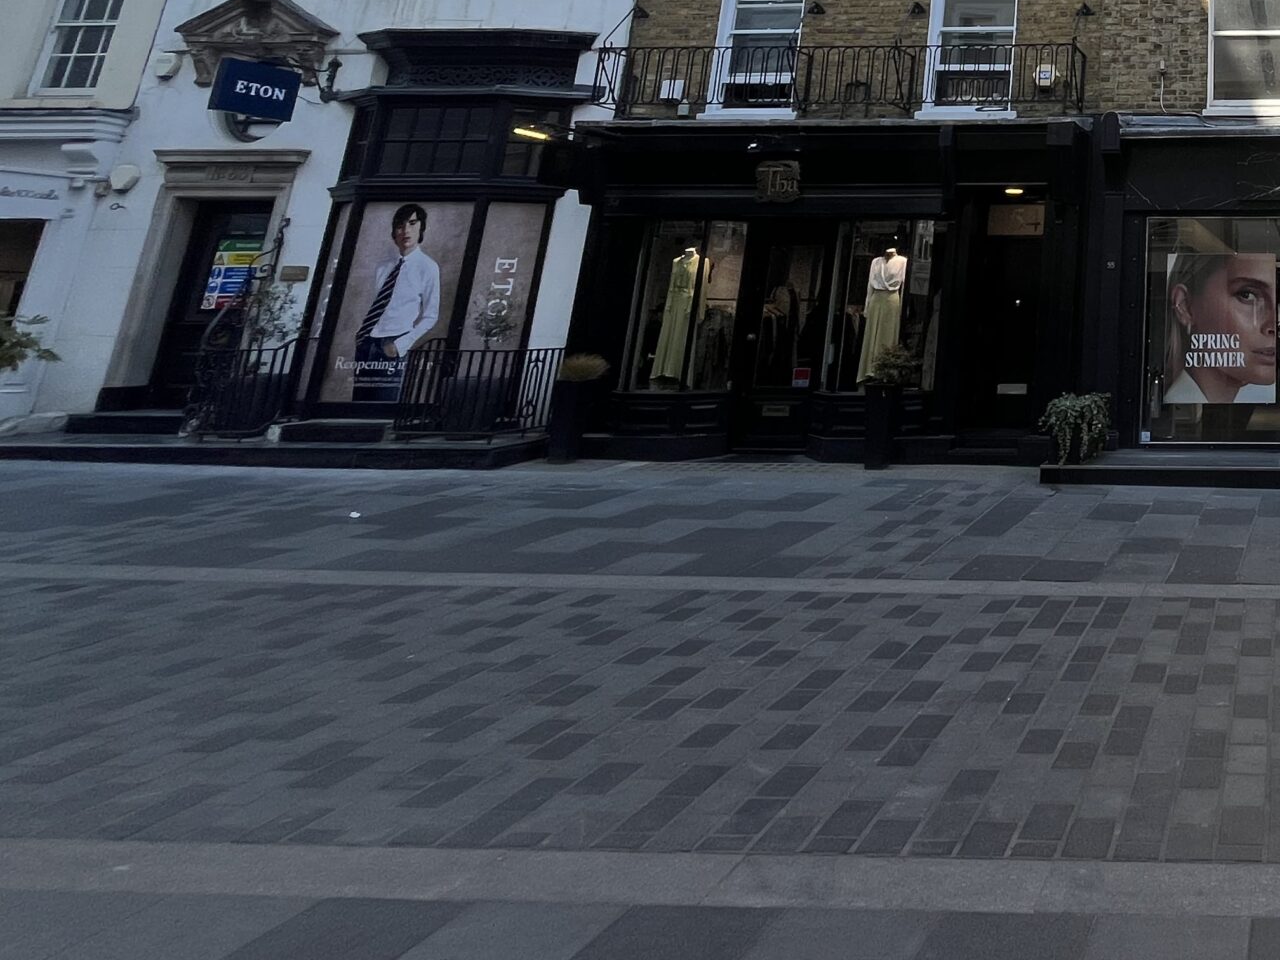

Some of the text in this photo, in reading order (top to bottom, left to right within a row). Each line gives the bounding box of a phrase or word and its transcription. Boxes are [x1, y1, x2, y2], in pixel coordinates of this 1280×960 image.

[234, 79, 287, 101] ETON
[1190, 333, 1240, 350] SPRING
[334, 355, 396, 375] Reopening
[1185, 351, 1246, 368] SUMMER
